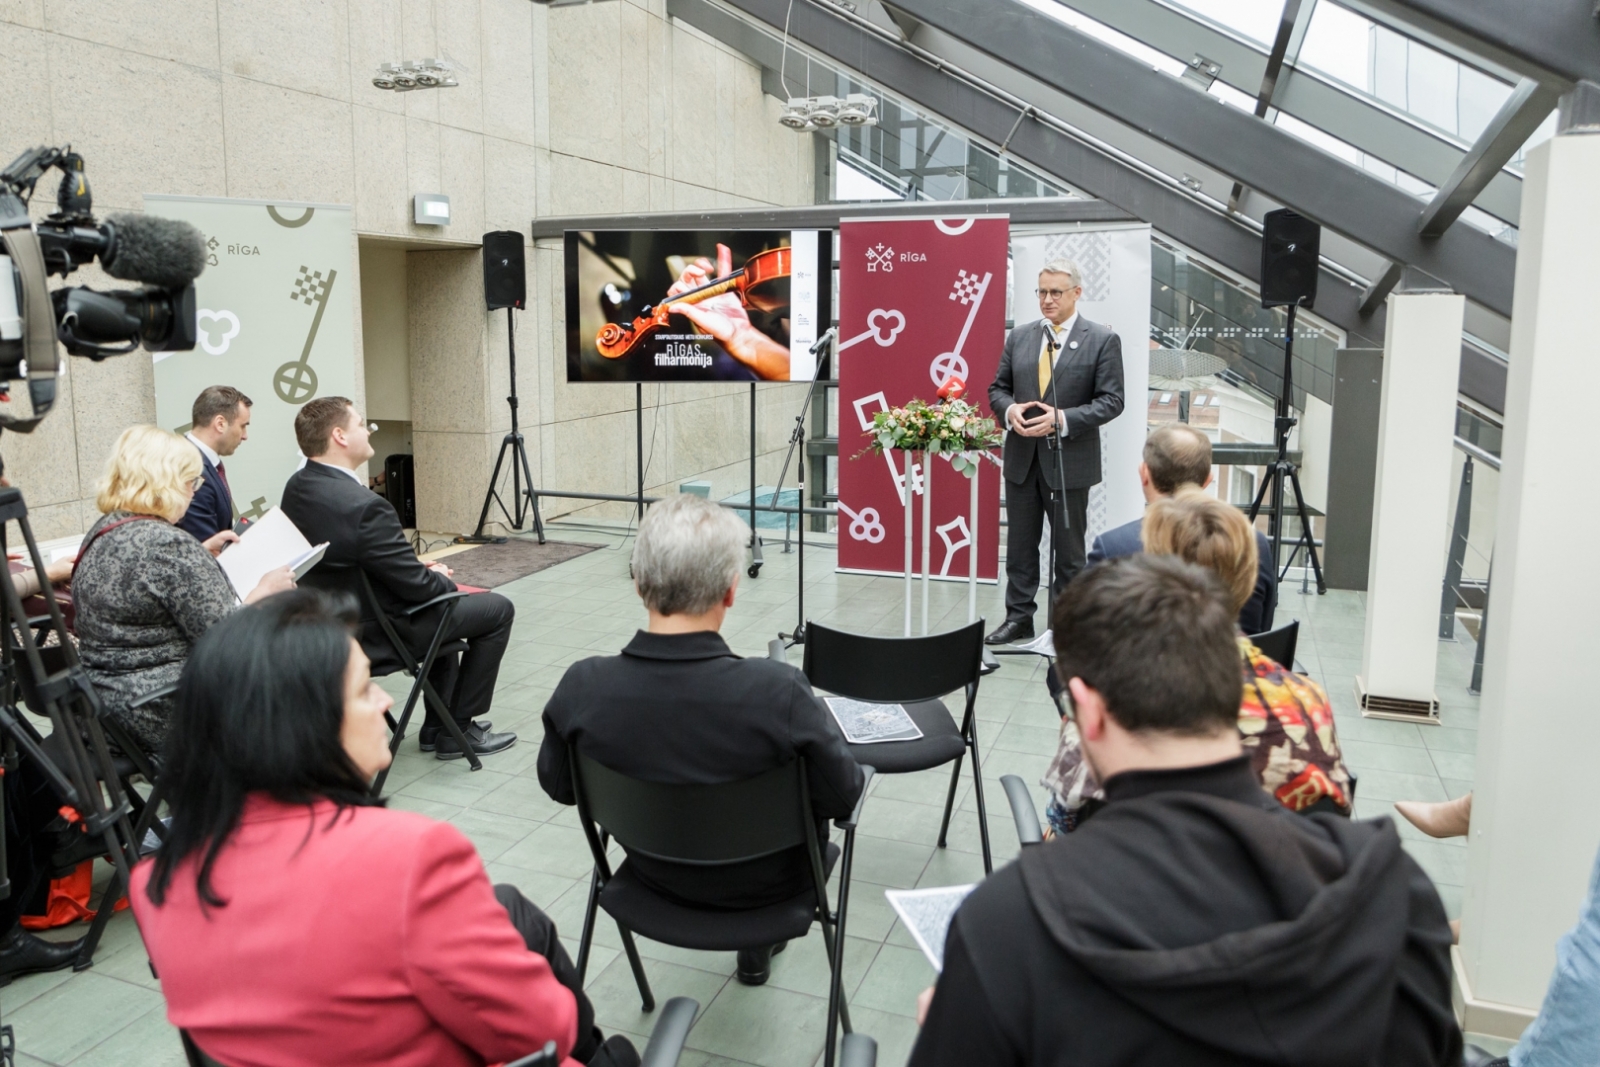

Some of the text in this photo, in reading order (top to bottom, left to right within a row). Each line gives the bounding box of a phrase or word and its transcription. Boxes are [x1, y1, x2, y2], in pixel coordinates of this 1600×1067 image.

[227, 243, 261, 256] RĪGA
[900, 251, 927, 262] RĪGA
[666, 341, 701, 357] RĪGAS
[654, 353, 713, 368] filharmonija
